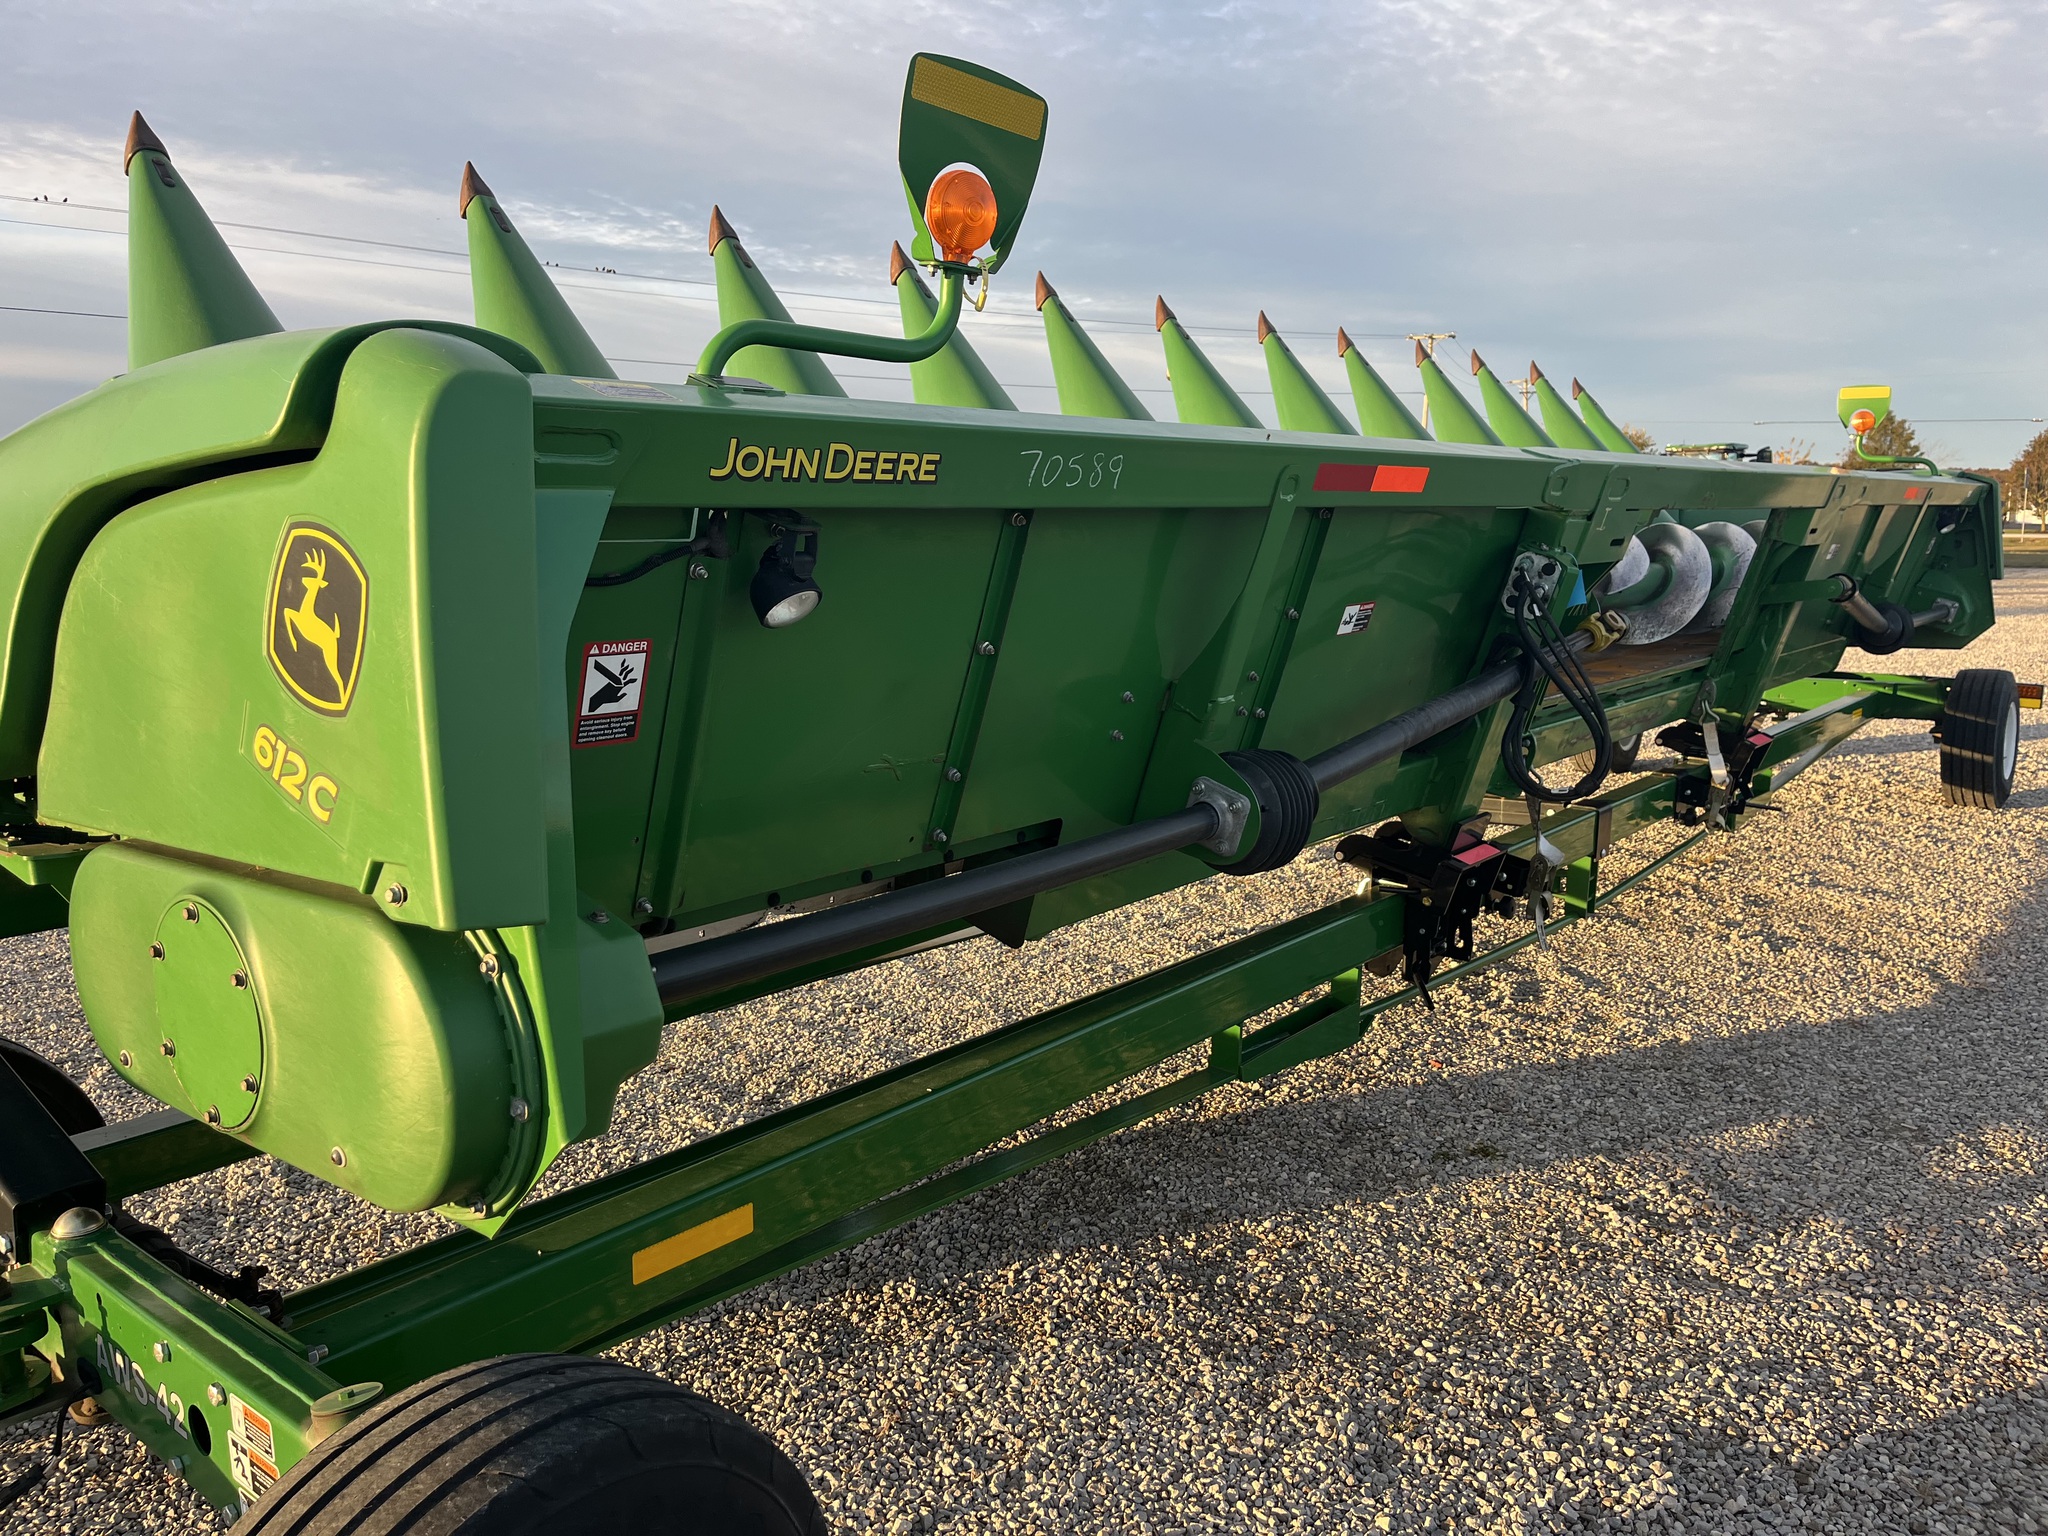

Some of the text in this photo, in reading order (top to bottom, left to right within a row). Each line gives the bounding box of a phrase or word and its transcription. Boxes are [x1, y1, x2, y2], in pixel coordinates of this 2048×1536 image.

[708, 437, 943, 485] JOHN DEERE
[1019, 449, 1125, 490] 70589
[602, 641, 648, 654] DANGER
[253, 723, 340, 825] 612C
[96, 1333, 188, 1440] AWS-42
